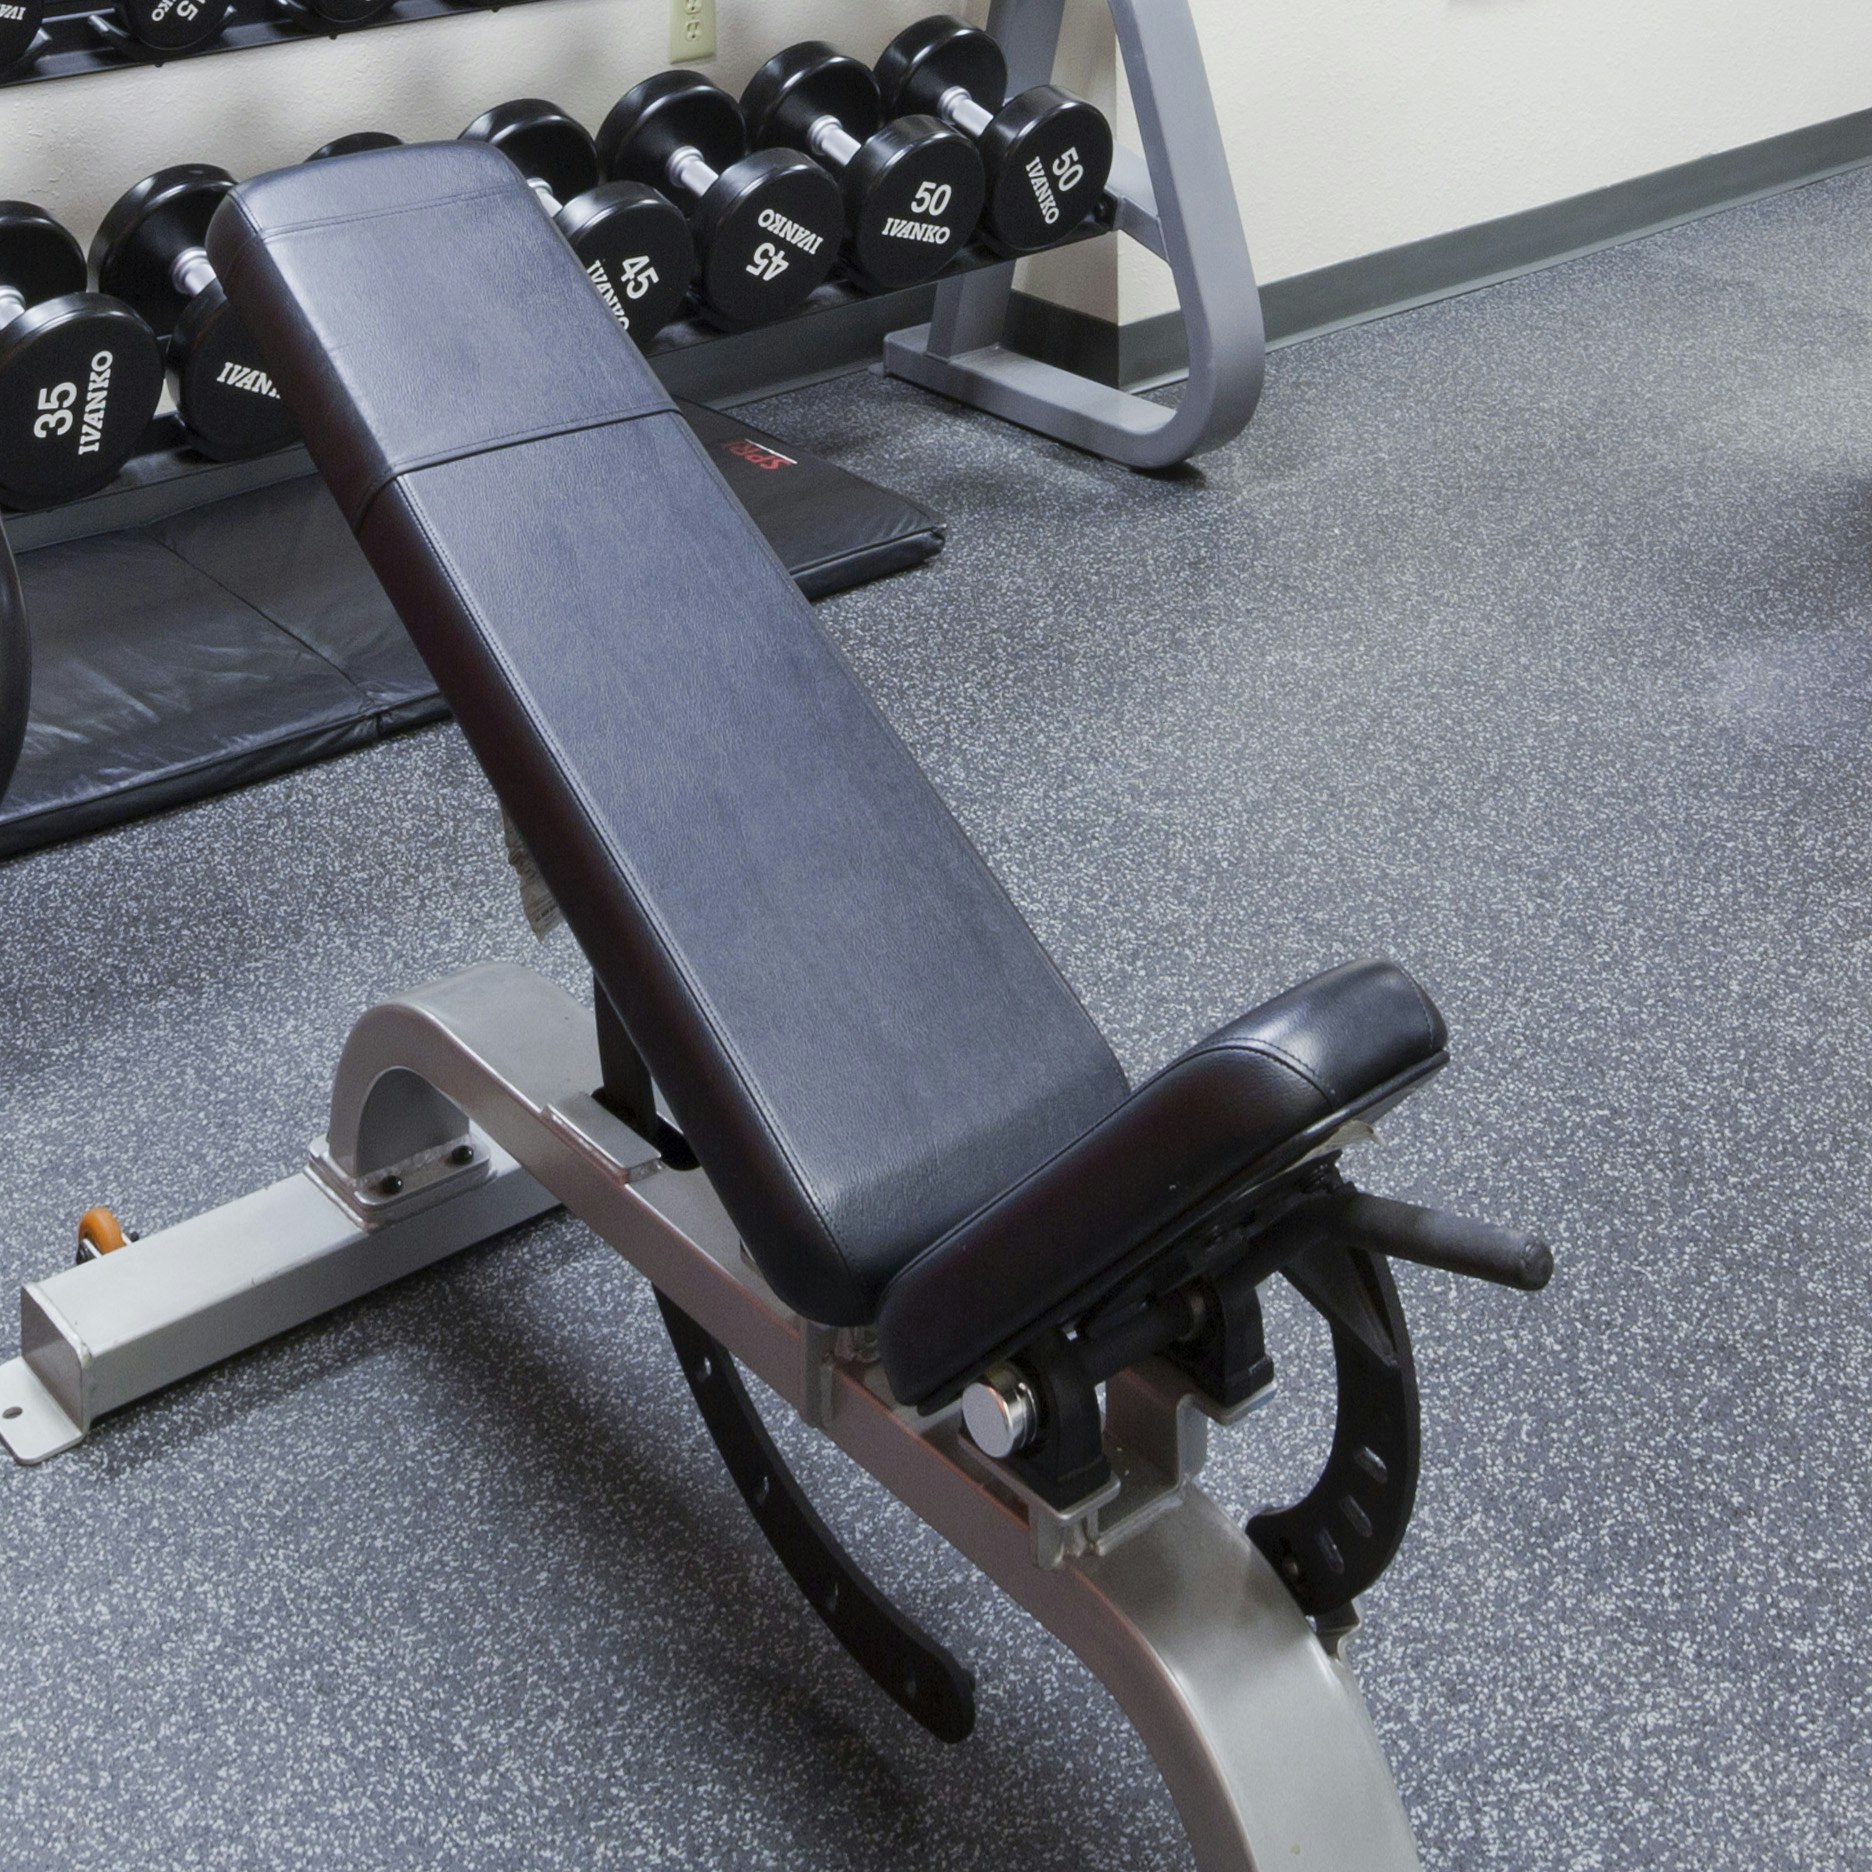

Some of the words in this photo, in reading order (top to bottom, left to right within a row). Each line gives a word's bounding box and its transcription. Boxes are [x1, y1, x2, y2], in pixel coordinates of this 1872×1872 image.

[1024, 155, 1059, 224] IVANKO
[1052, 146, 1084, 192] 50
[910, 181, 952, 216] 50
[757, 208, 823, 255] IVANKO
[881, 216, 951, 245] IVANKO
[620, 255, 660, 299] 45
[745, 242, 790, 282] 45
[34, 381, 77, 438] 35
[78, 350, 113, 456] IVANKO
